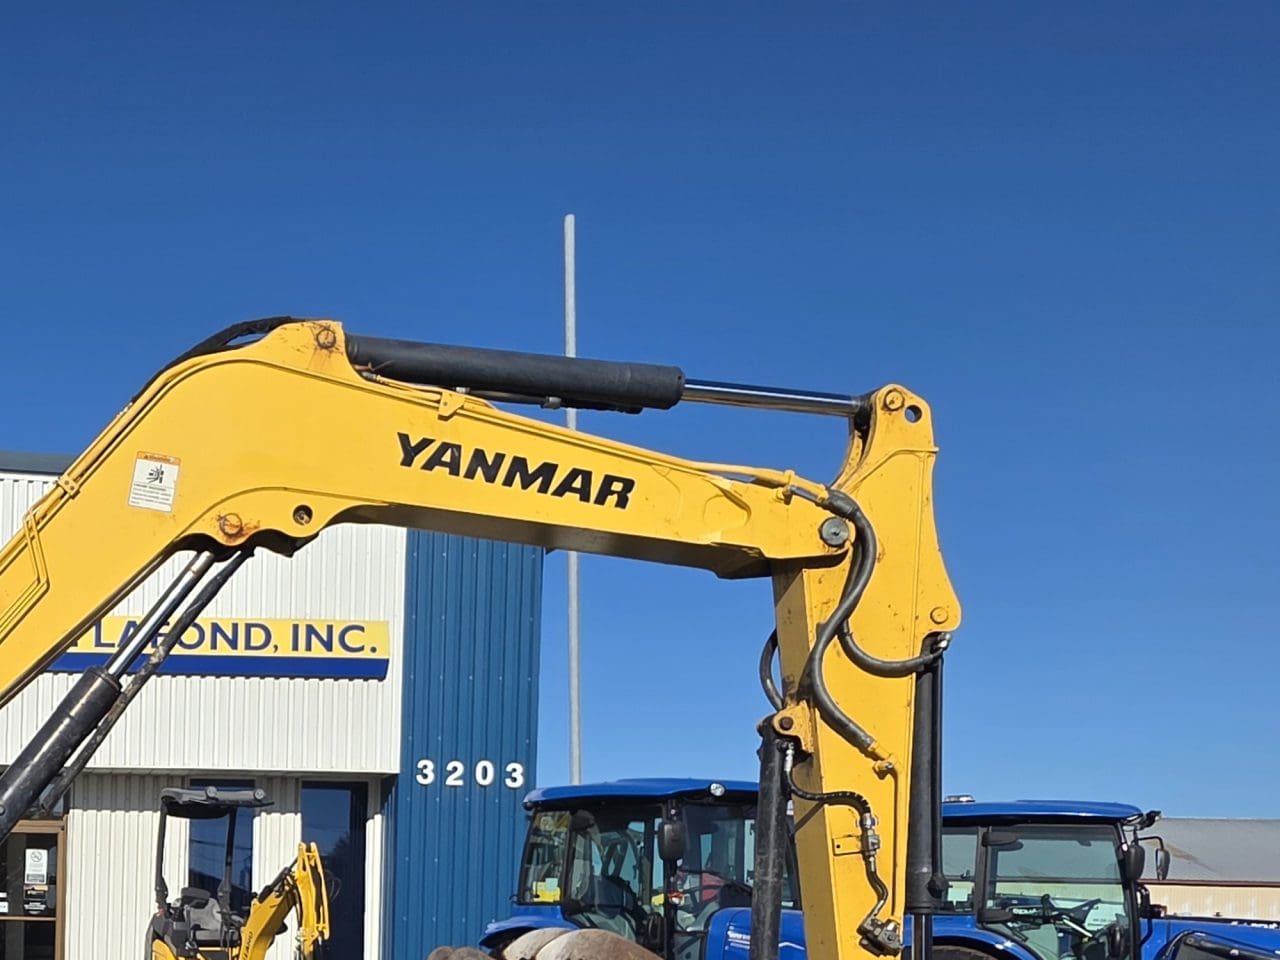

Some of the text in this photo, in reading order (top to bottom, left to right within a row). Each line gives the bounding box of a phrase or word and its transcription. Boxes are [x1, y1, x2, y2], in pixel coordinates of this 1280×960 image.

[397, 432, 635, 509] YANMAR
[290, 623, 378, 654] INC.
[415, 759, 524, 788] 3203
